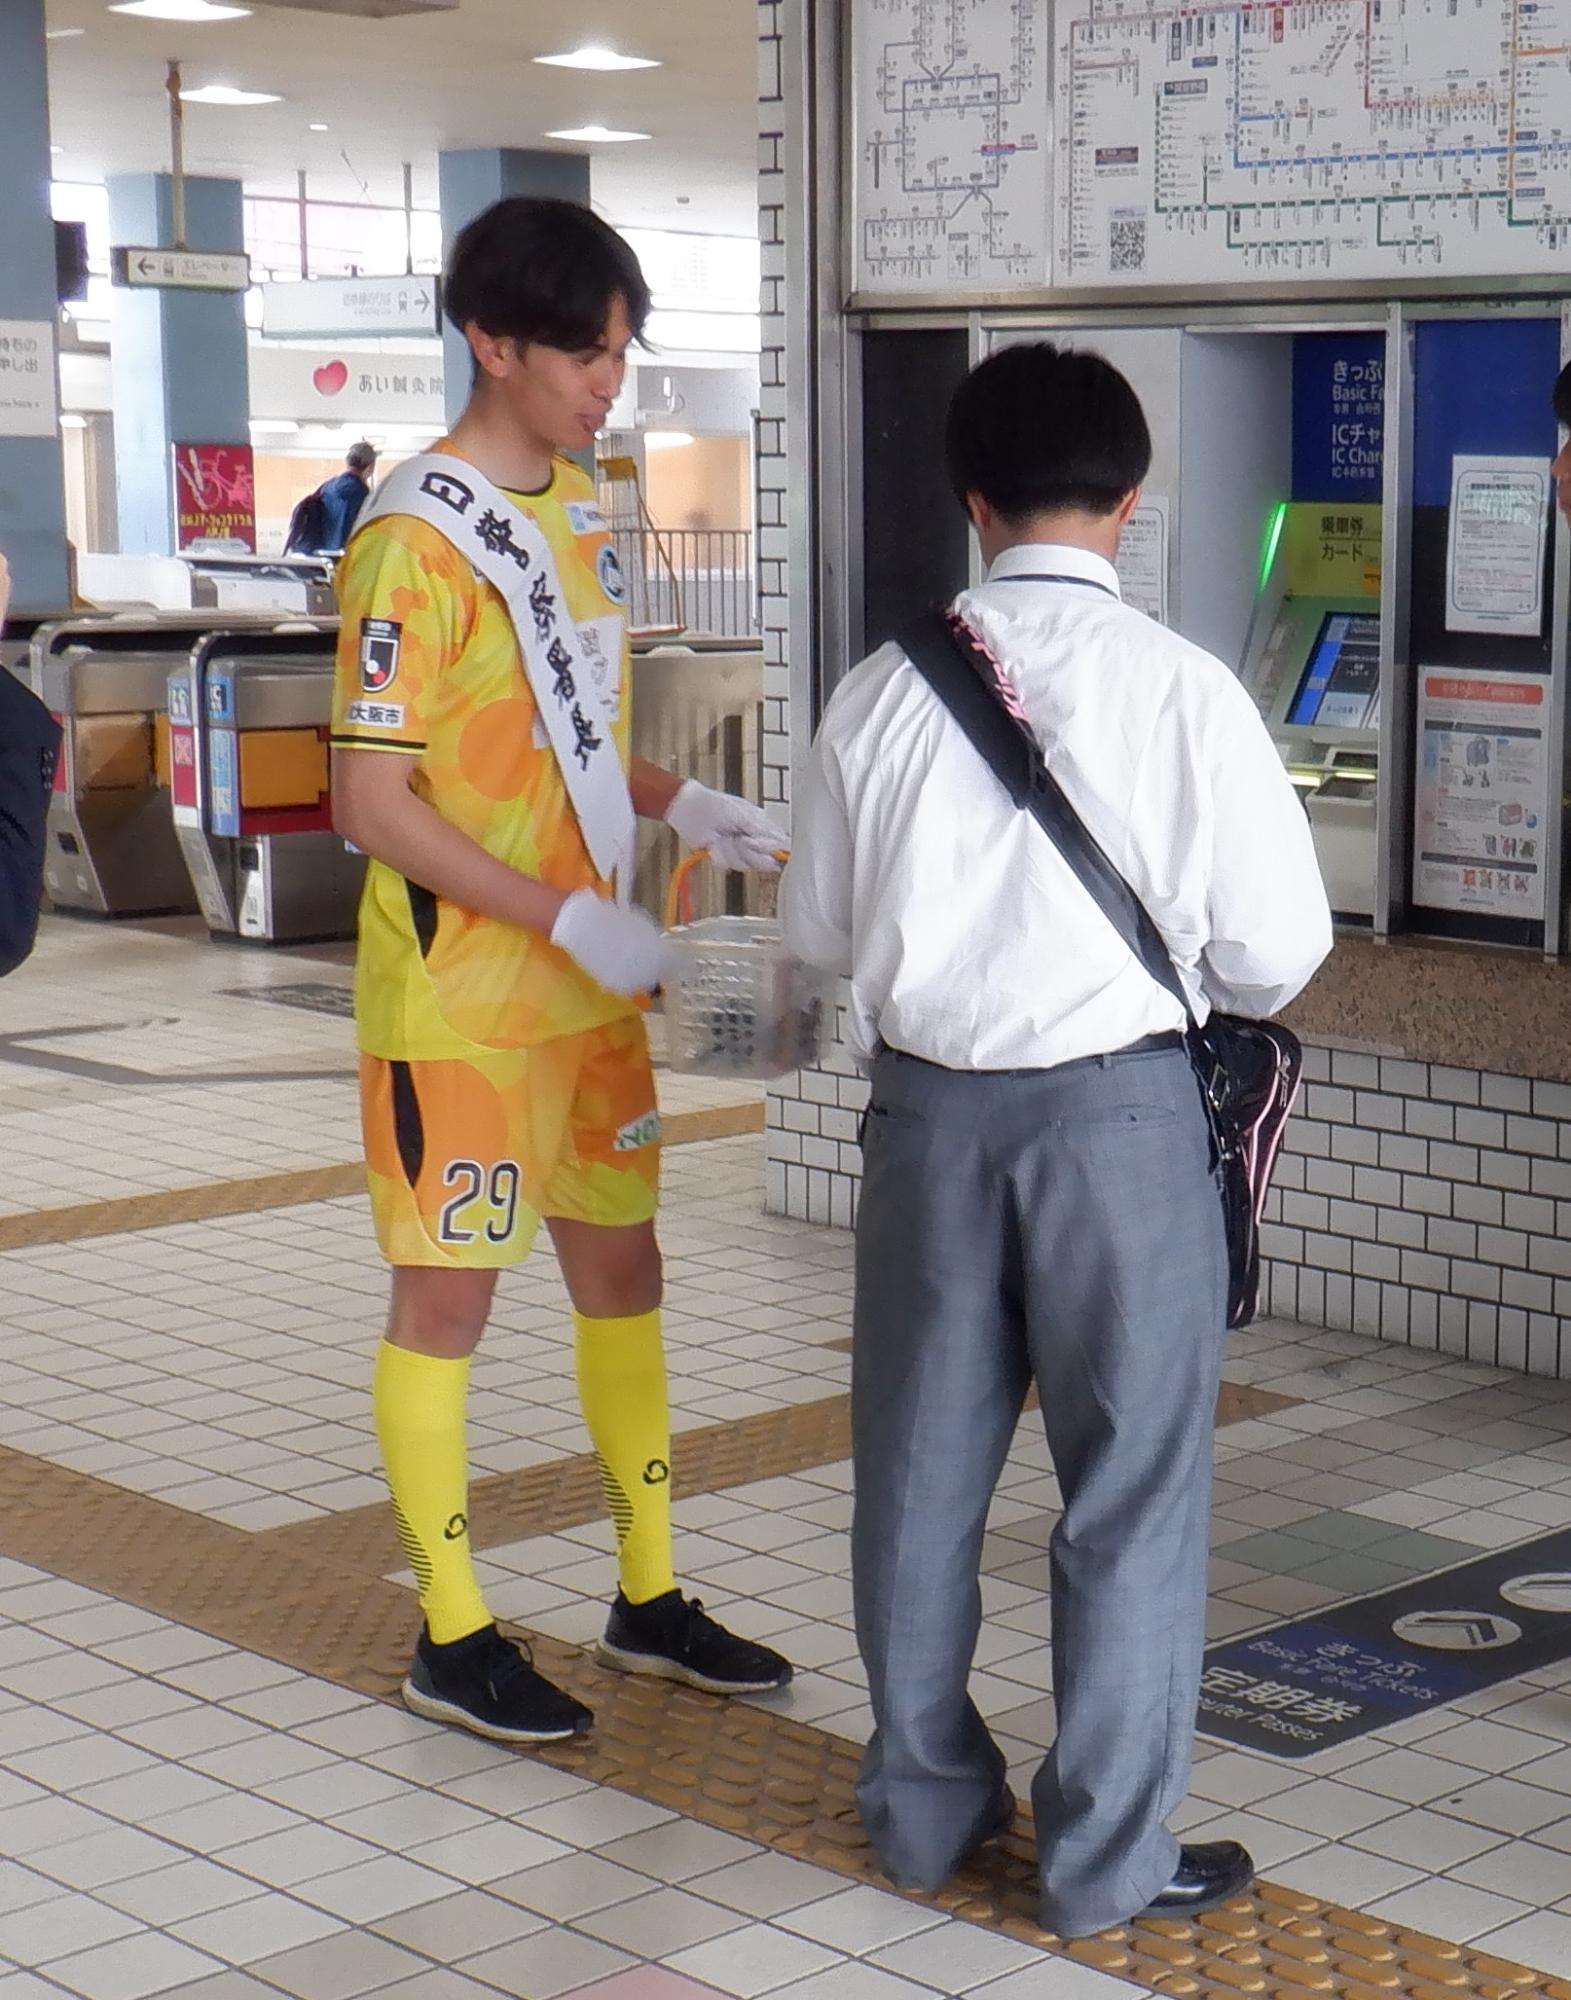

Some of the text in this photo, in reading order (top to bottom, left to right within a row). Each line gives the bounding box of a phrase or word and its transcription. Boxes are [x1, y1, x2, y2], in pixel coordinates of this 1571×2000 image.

[1333, 360, 1382, 382] きっぷ
[358, 374, 443, 395] あい鍼灸院
[1332, 384, 1366, 401] Basic
[1332, 447, 1345, 464] IC
[1321, 544, 1363, 562] カード
[350, 703, 400, 724] 大阪市
[438, 1159, 520, 1244] 29
[1316, 1641, 1427, 1676] きっぷ
[1248, 1640, 1308, 1662] Basic
[1304, 1655, 1358, 1677] Fare
[1360, 1671, 1439, 1700] Tickets
[1201, 1666, 1363, 1723] 定期券
[1248, 1712, 1324, 1741] Passes
